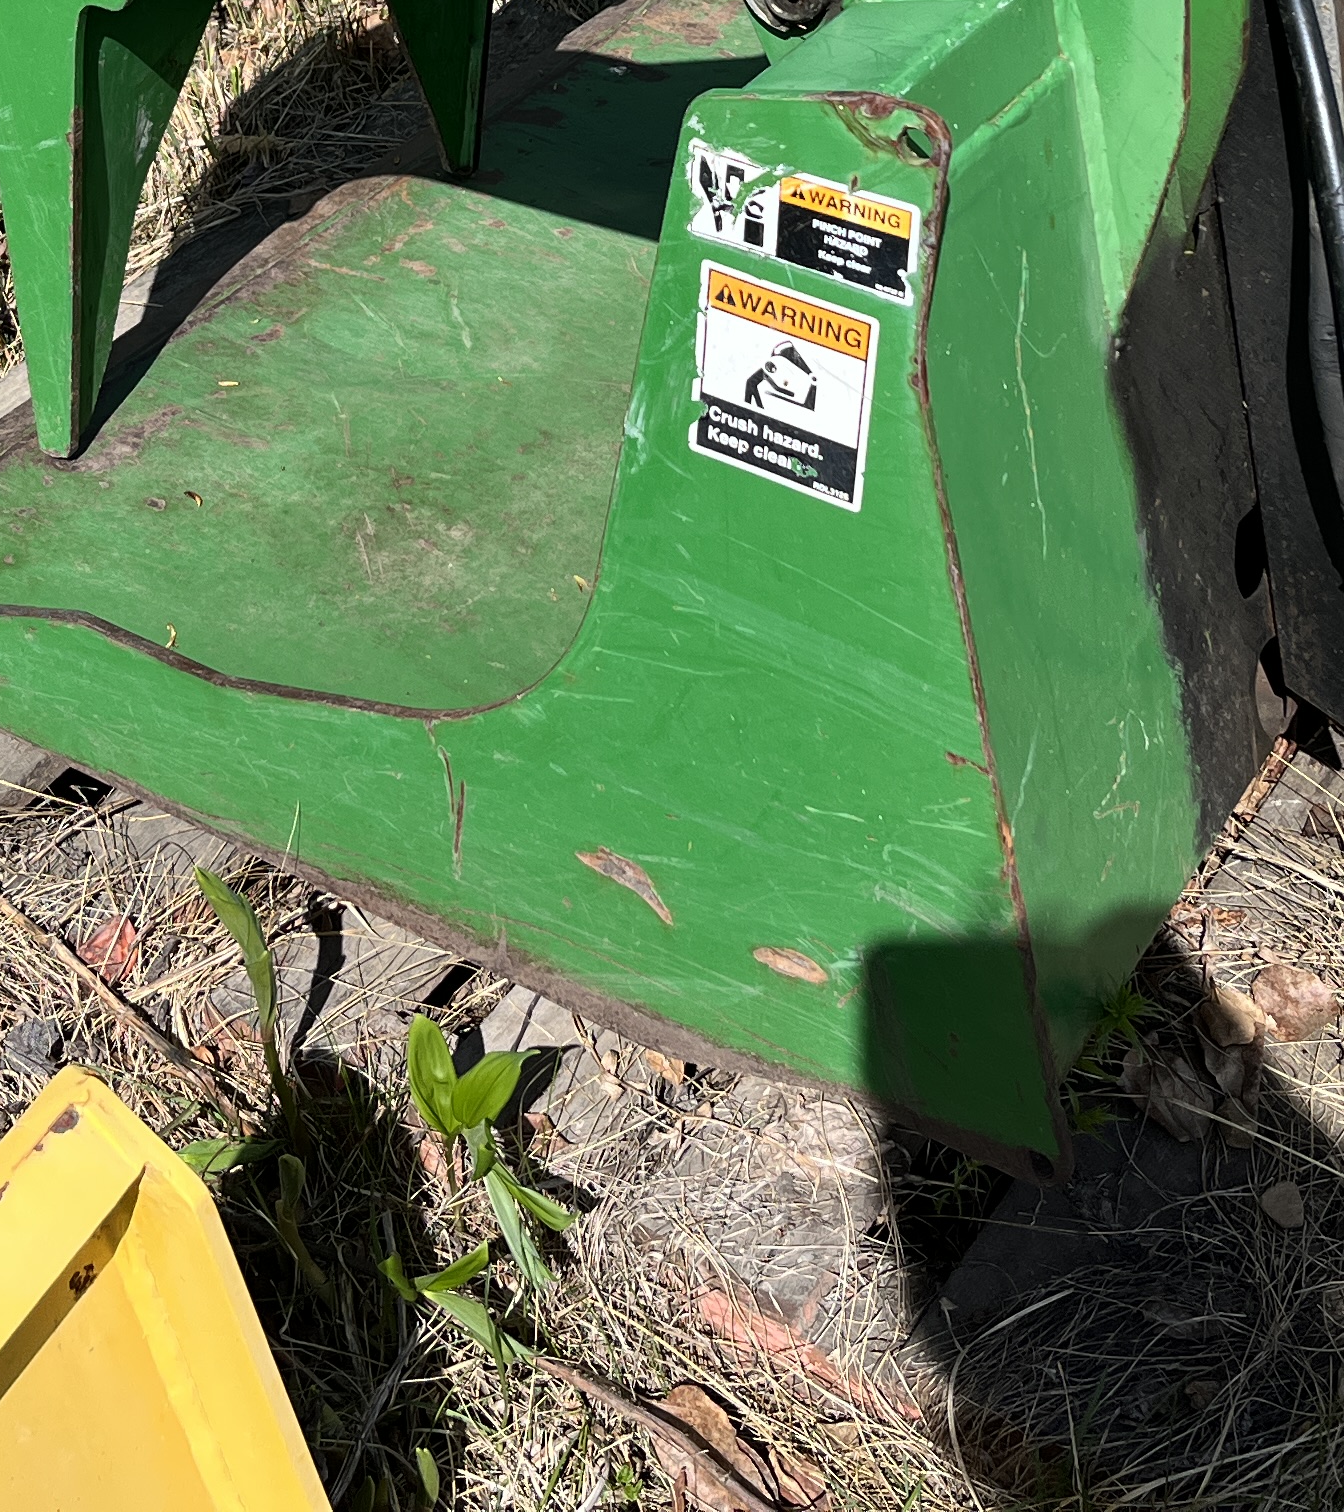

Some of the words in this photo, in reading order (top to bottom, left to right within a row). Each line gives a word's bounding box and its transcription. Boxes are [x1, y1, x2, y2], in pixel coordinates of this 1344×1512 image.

[809, 189, 902, 230] WARNING
[812, 218, 847, 237] PINCH
[848, 229, 882, 248] POINT
[823, 234, 869, 257] HAZARD
[817, 249, 845, 266] Keep
[739, 289, 862, 349] WARNING
[707, 424, 750, 455] Keep
[709, 405, 759, 437] Crush
[762, 424, 824, 461] hazard.
